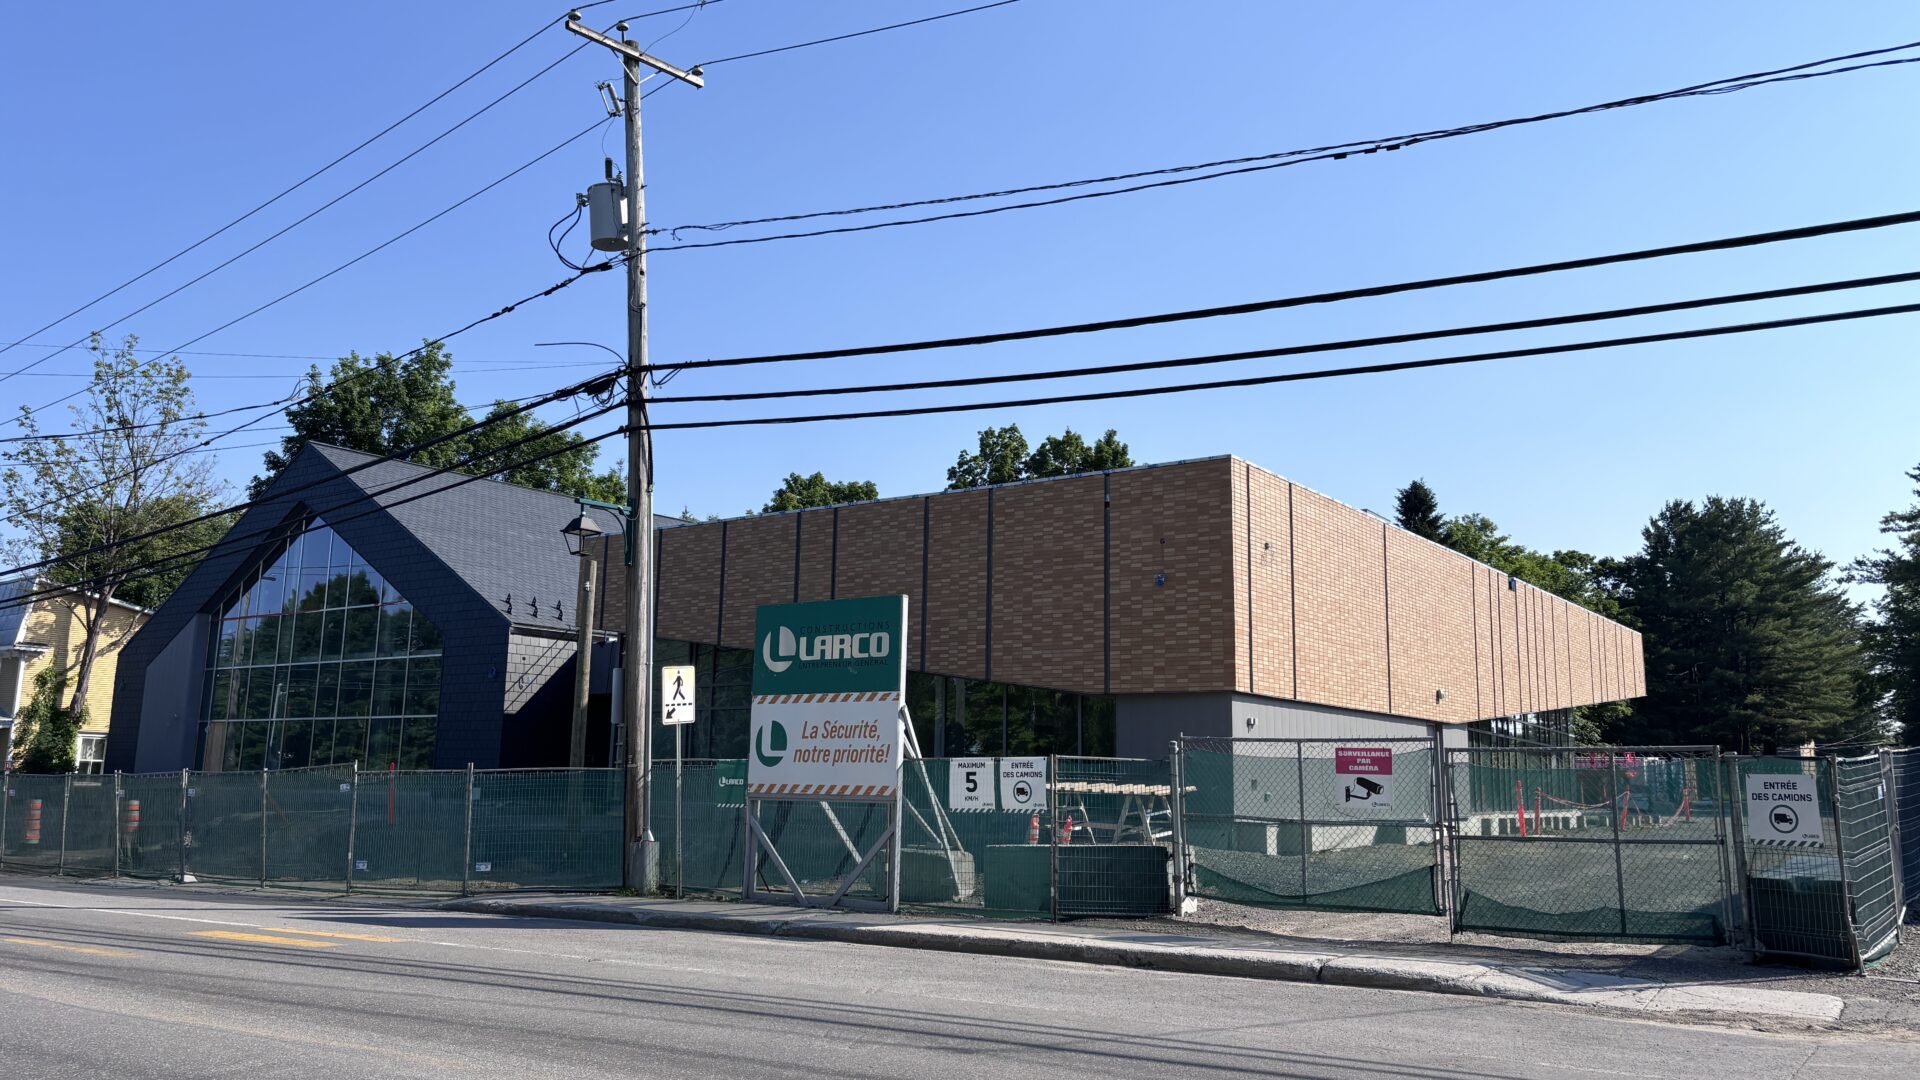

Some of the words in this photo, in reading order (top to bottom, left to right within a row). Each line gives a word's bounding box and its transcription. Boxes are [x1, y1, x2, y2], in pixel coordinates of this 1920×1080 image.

[801, 621, 890, 635] CONSTRUCTIONS
[799, 632, 890, 661] LARCO
[802, 721, 819, 739] La
[822, 719, 881, 741] Sécurité,
[793, 746, 831, 763] notre
[832, 744, 891, 766] priorité!
[1011, 761, 1034, 769] ENTRÉE
[965, 771, 978, 793] 5
[1763, 780, 1798, 790] ENTRÉE
[1751, 793, 1769, 801] DES
[1771, 793, 1813, 802] CAMIONS
